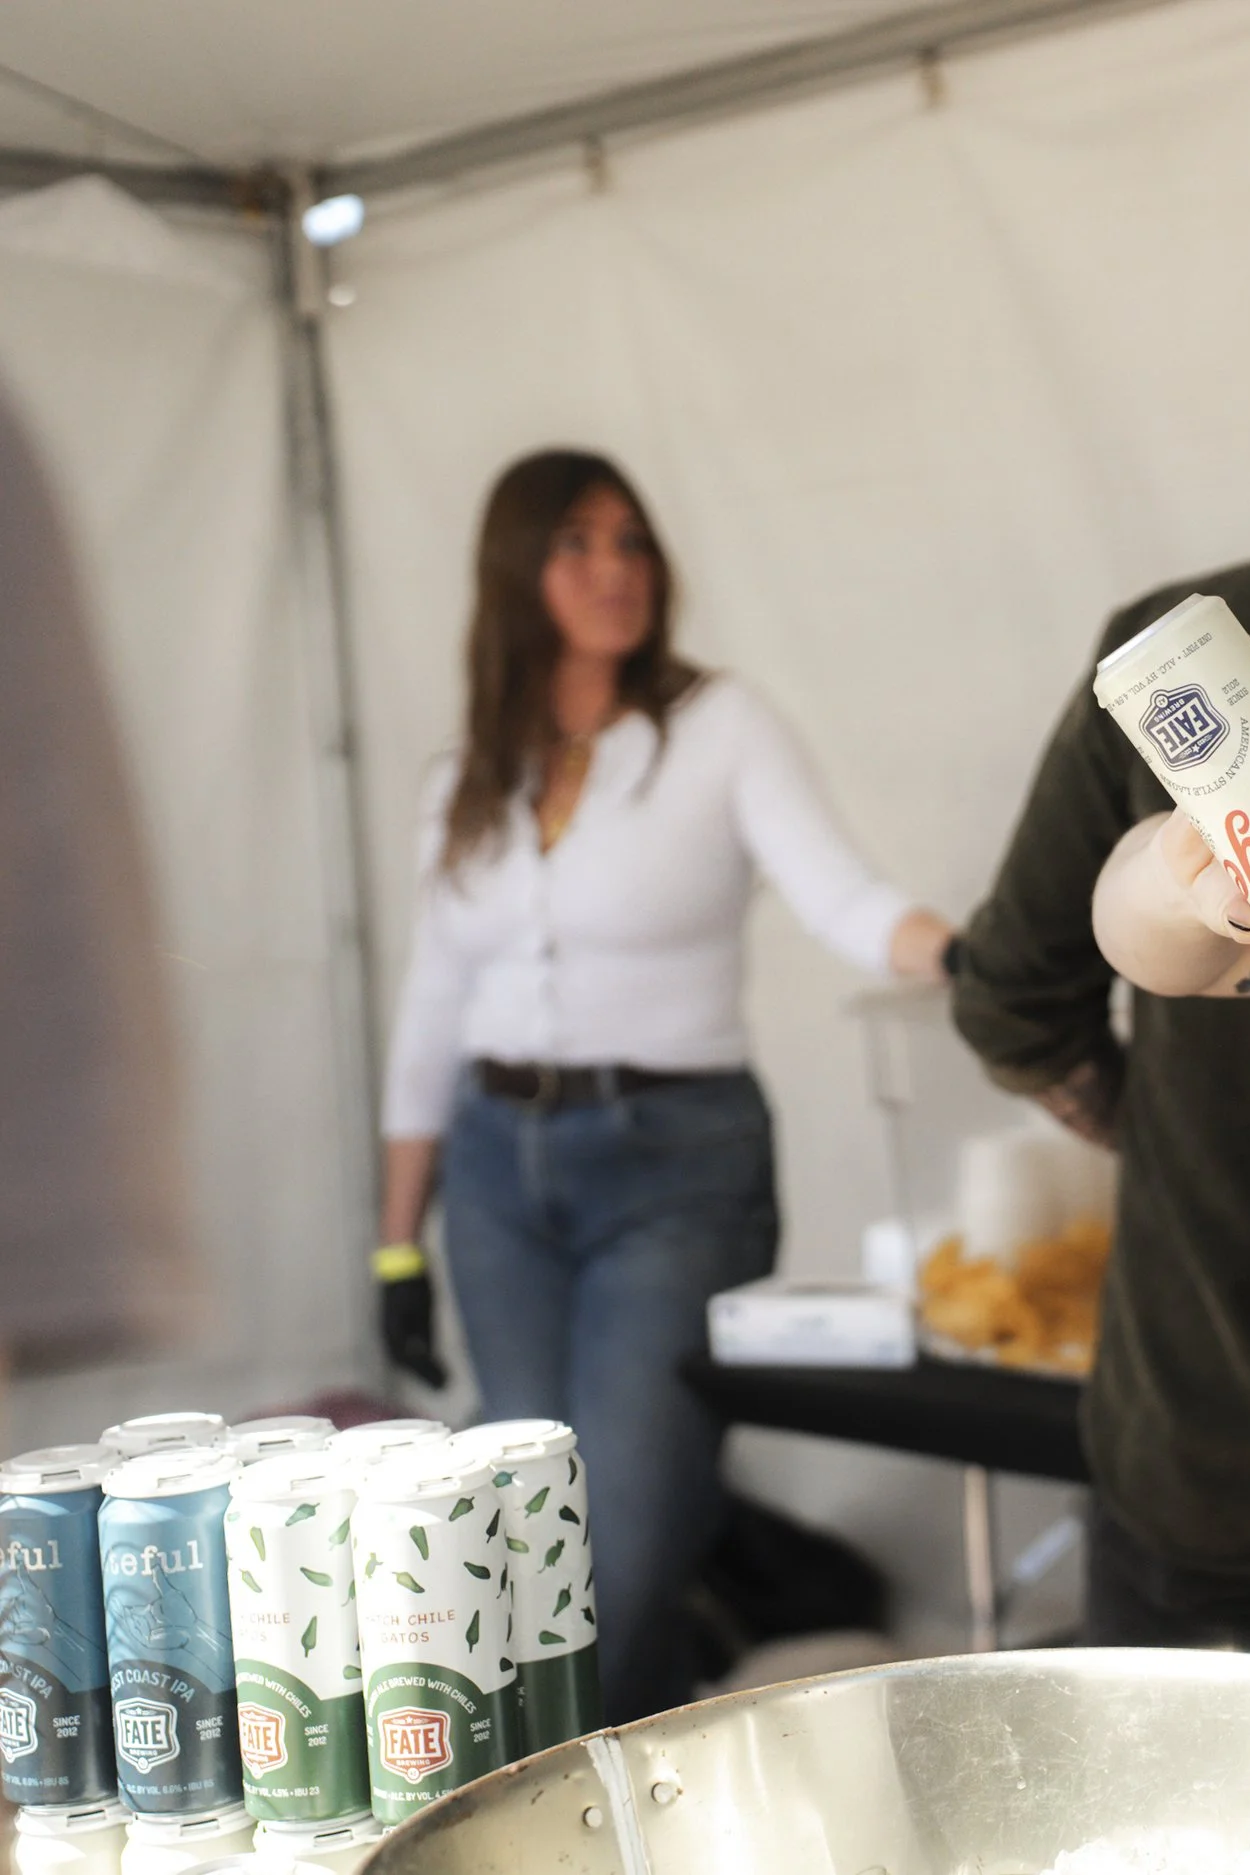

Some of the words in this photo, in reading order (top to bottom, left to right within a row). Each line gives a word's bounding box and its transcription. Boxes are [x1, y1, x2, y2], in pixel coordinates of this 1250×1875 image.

[1200, 632, 1213, 647] ONE
[1182, 640, 1201, 658] PINT
[1145, 671, 1159, 686] BY
[1221, 678, 1240, 695] 2012
[1226, 686, 1250, 706] SINCE
[1154, 698, 1185, 723] BREWING
[1155, 703, 1211, 753] FATE
[1225, 716, 1250, 780] AMERICAN
[1192, 776, 1227, 797] STYLE
[408, 1609, 456, 1626] CHILE
[30, 1674, 53, 1699] IPA
[125, 1668, 171, 1689] COAST
[169, 1679, 196, 1703] IPA
[265, 1677, 287, 1697] WITH
[285, 1691, 312, 1719] CHILES
[388, 1676, 426, 1689] BREWED
[427, 1678, 453, 1695] WITH
[450, 1688, 477, 1714] CHILES
[52, 1715, 81, 1728] SINCE
[195, 1715, 223, 1731] SINCE
[304, 1724, 329, 1736] SINCE
[470, 1718, 491, 1732] SINCE
[56, 1727, 79, 1739] 2012
[123, 1719, 164, 1745] FATE
[200, 1728, 222, 1741] 2012
[389, 1727, 437, 1754] FATE
[473, 1731, 490, 1743] 2012
[308, 1736, 327, 1747] 2012
[395, 1758, 431, 1767] BREWING
[309, 1786, 320, 1796] 23
